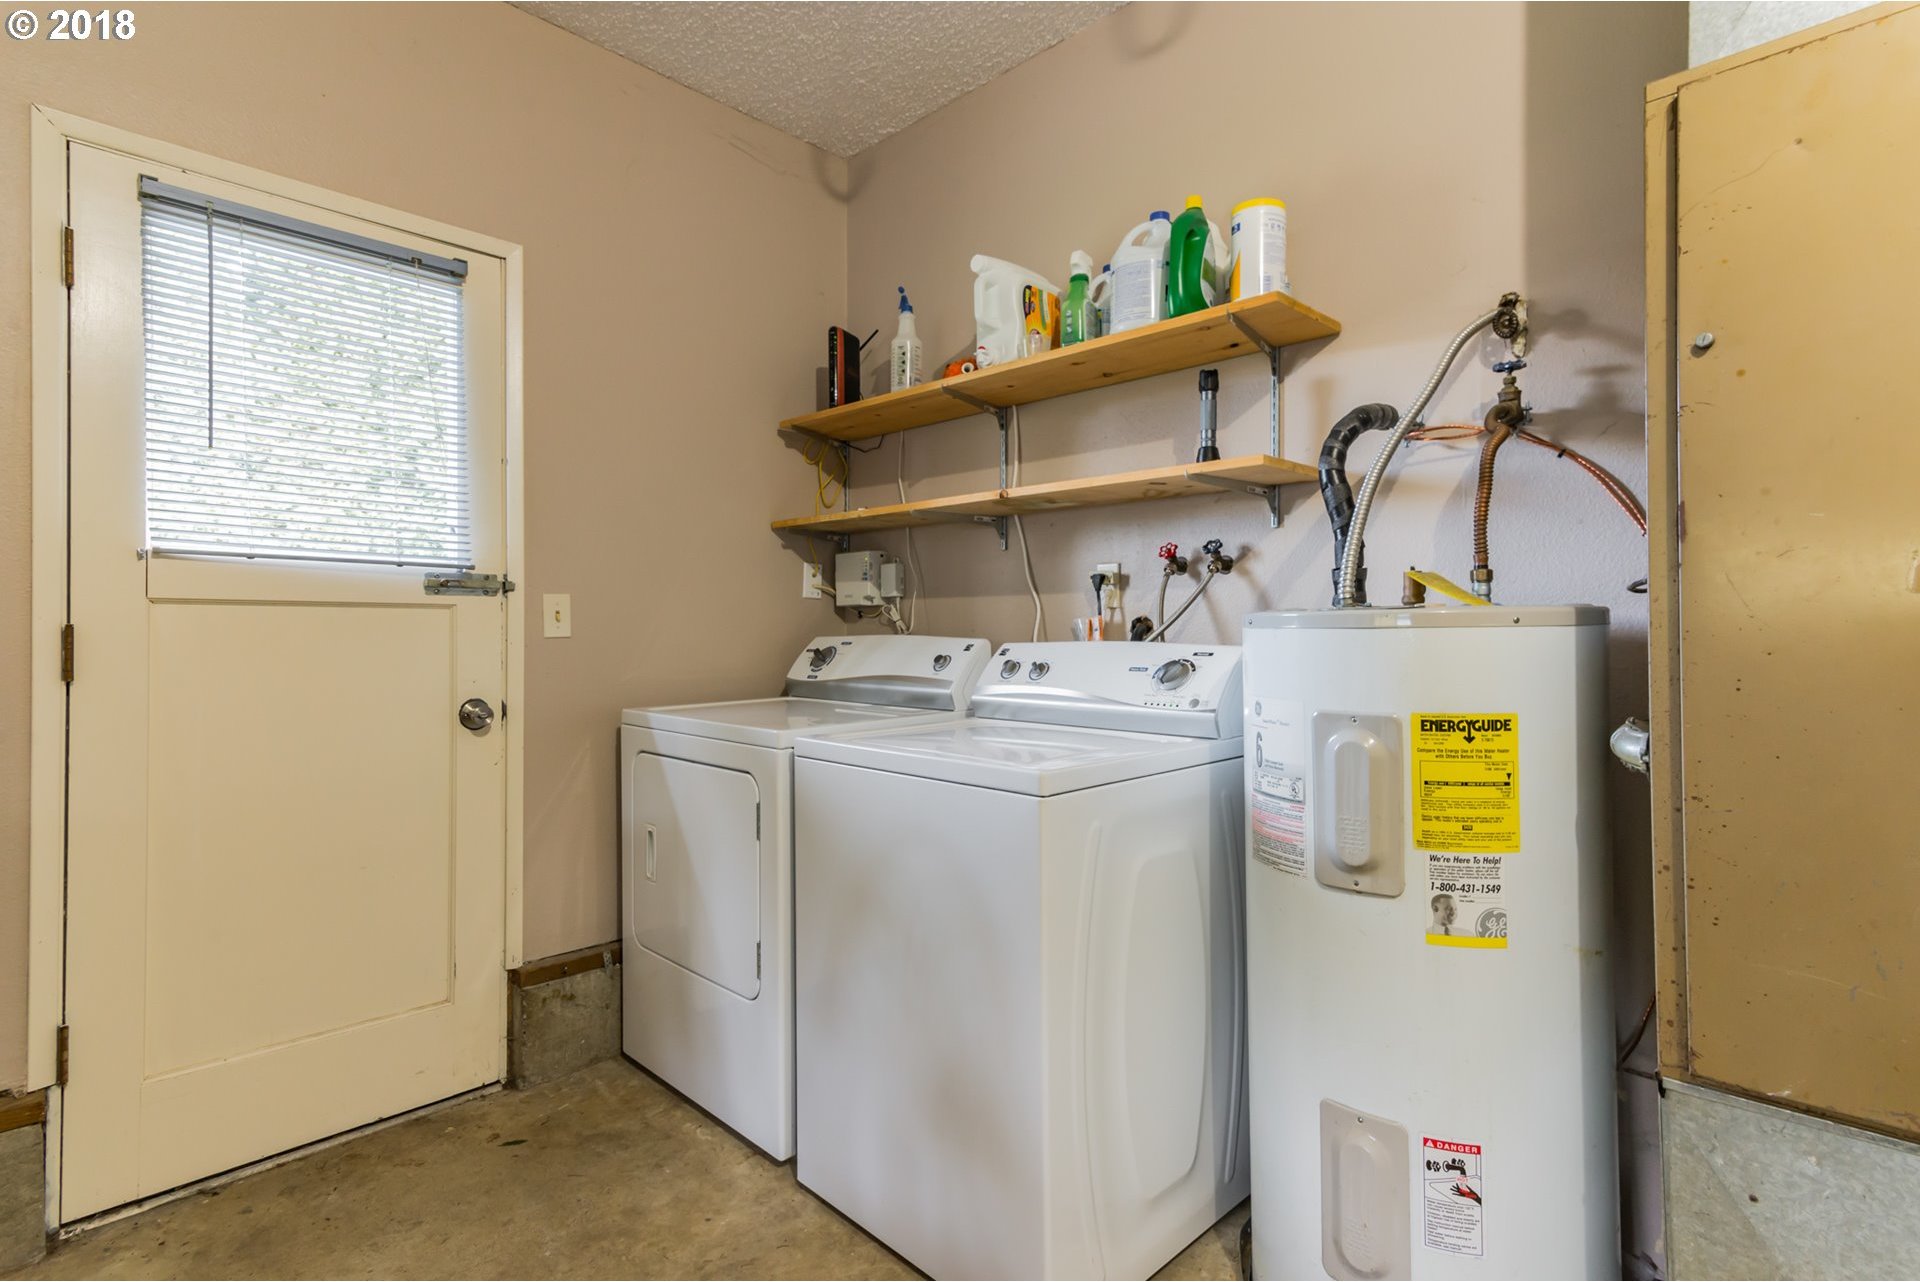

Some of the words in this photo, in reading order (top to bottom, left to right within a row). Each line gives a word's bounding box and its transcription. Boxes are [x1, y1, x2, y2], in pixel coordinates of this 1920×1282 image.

[1420, 719, 1512, 733] ENERGYGUIDE
[1256, 731, 1263, 768] 6
[1429, 854, 1451, 863] We're
[1453, 856, 1471, 864] Here
[1473, 856, 1481, 864] To
[1482, 856, 1502, 866] Help!
[1430, 881, 1502, 894] 1-800-431-1549
[1436, 1141, 1478, 1154] DANGER
